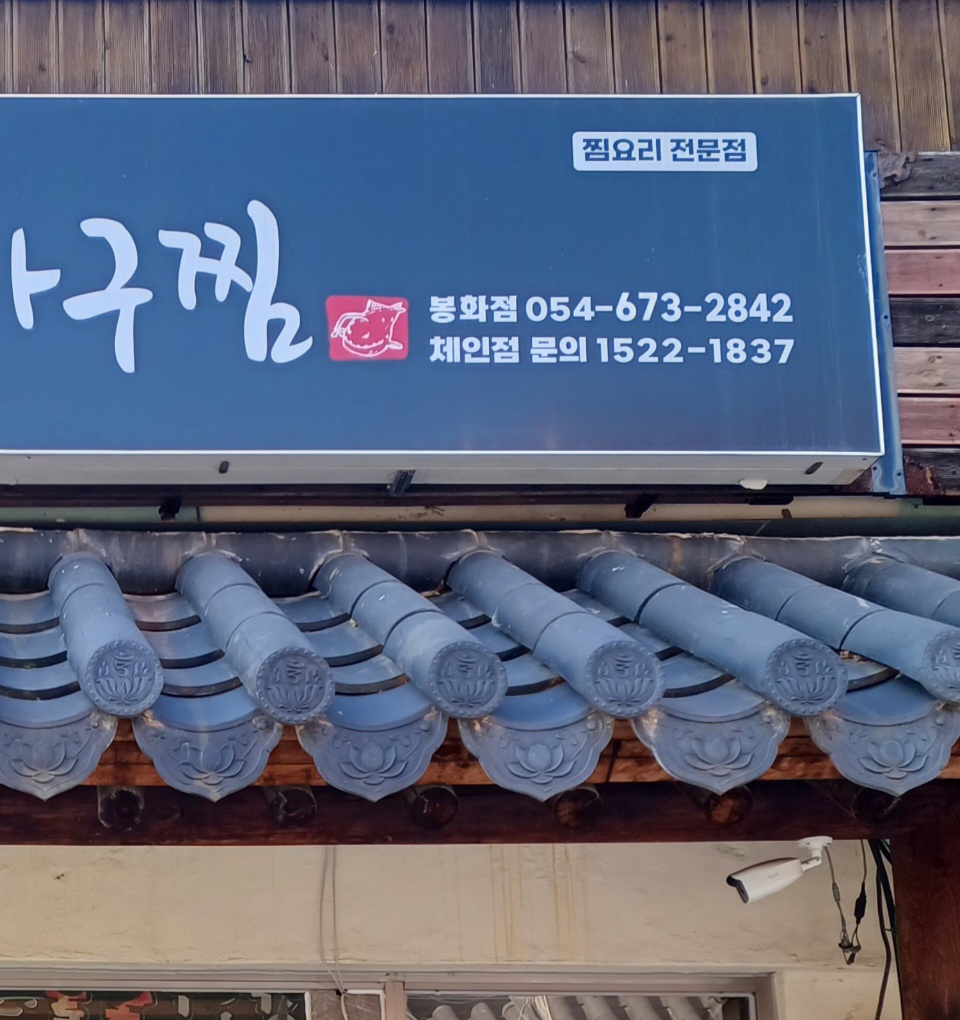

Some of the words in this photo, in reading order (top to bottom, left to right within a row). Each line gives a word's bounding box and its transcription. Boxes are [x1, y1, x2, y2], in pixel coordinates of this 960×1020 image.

[582, 138, 662, 163] 찜요리
[670, 138, 747, 163] 전문점
[429, 295, 518, 323] 봉화점
[525, 292, 794, 322] 054-673-2842
[429, 336, 520, 364] 체인점
[530, 336, 588, 364] 문의
[596, 337, 795, 364] 1522-1837
